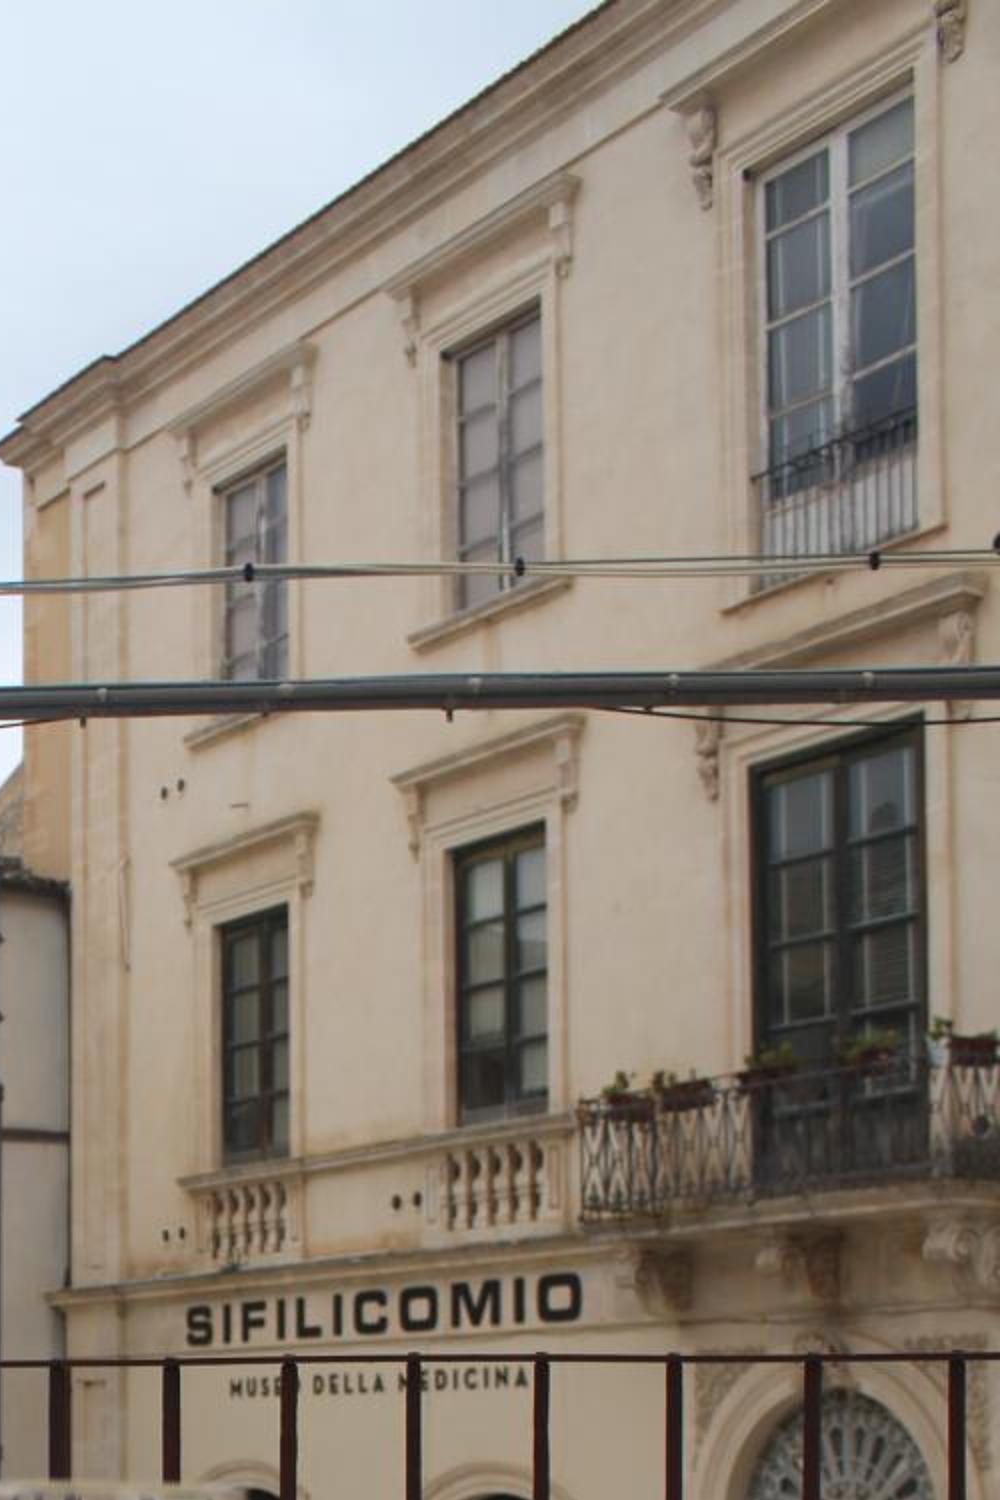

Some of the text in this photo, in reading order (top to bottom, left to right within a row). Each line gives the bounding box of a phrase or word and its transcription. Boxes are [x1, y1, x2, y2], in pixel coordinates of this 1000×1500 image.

[186, 1273, 582, 1346] SIFILICOMIO
[230, 1373, 302, 1397] MUSE
[312, 1373, 384, 1395] DELLA
